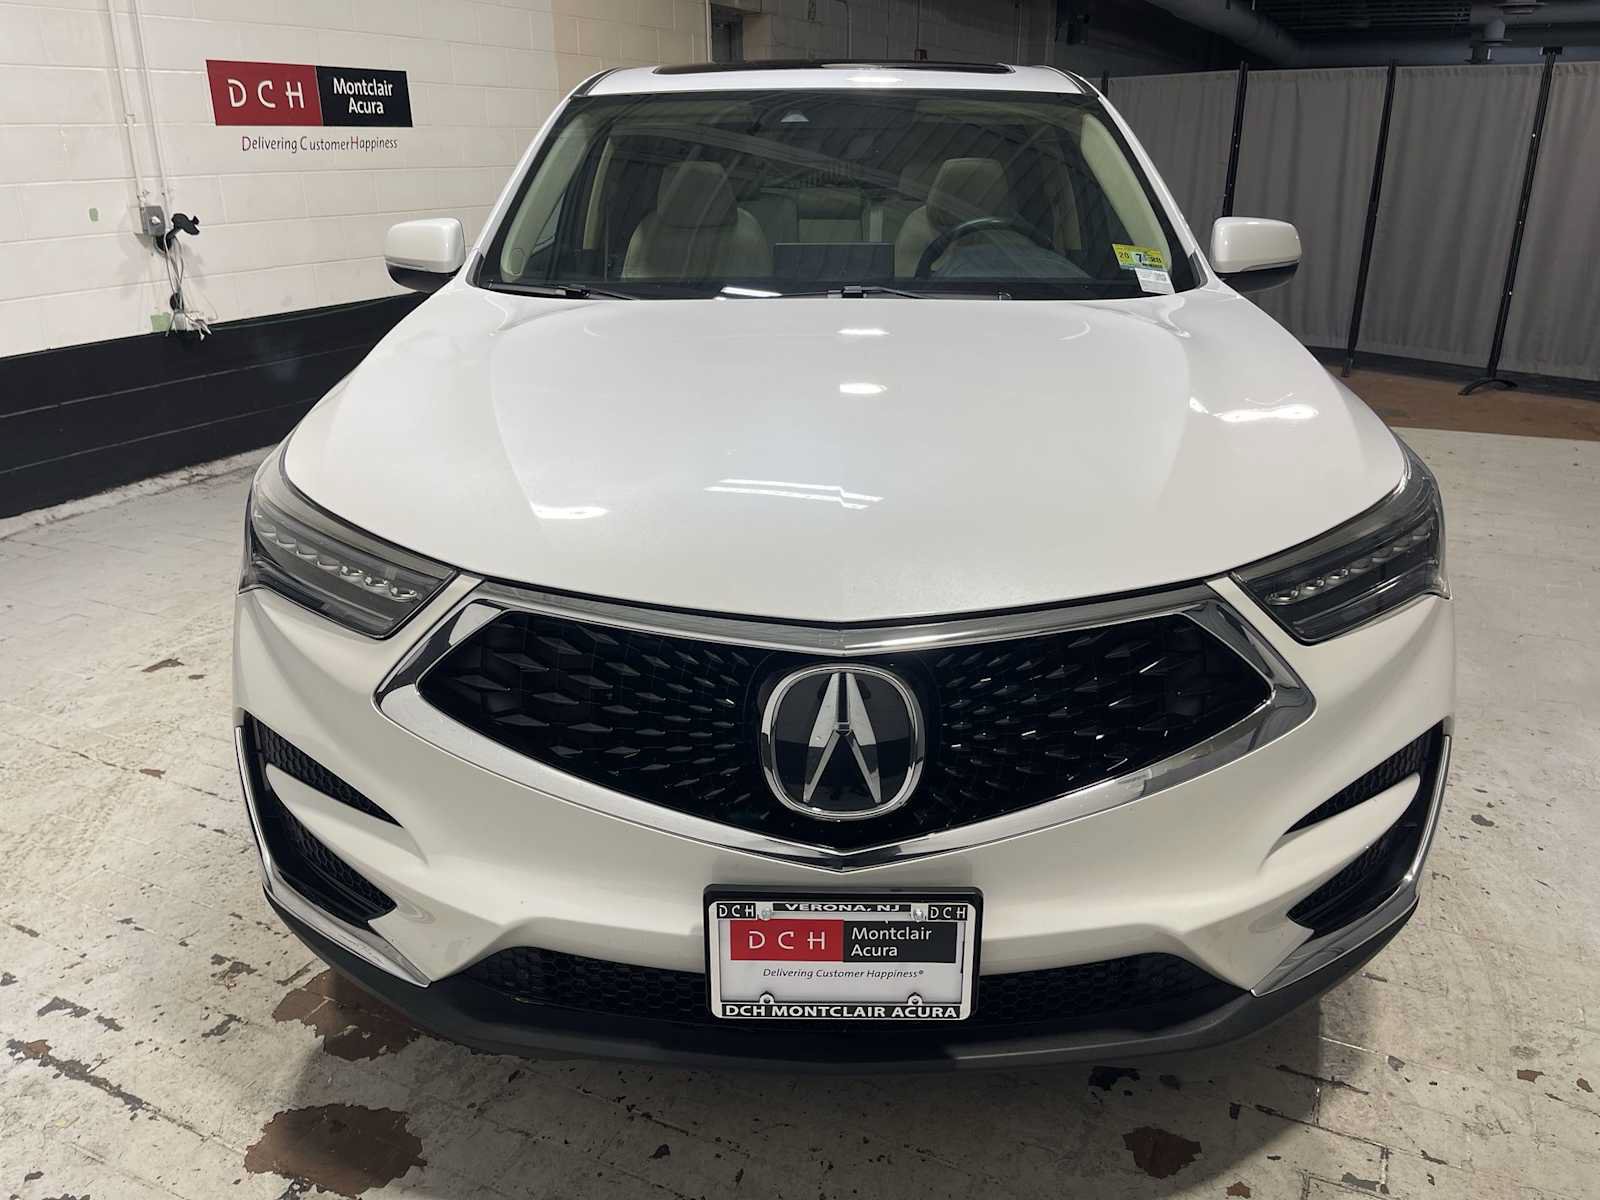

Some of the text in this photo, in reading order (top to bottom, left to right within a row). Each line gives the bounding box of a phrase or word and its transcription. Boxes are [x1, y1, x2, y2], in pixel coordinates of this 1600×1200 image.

[332, 77, 393, 97] Montclair
[349, 97, 384, 115] Acura
[241, 135, 298, 154] Delivering
[718, 904, 755, 917] DCH
[785, 903, 900, 913] VERONA, NJ
[930, 905, 967, 919] DCH
[851, 927, 932, 941] Montclair
[851, 944, 898, 957] Acura
[763, 968, 813, 980] Delivering
[815, 969, 865, 978] Customer
[725, 1005, 958, 1018] DCH MONTCLAIR ACURA
